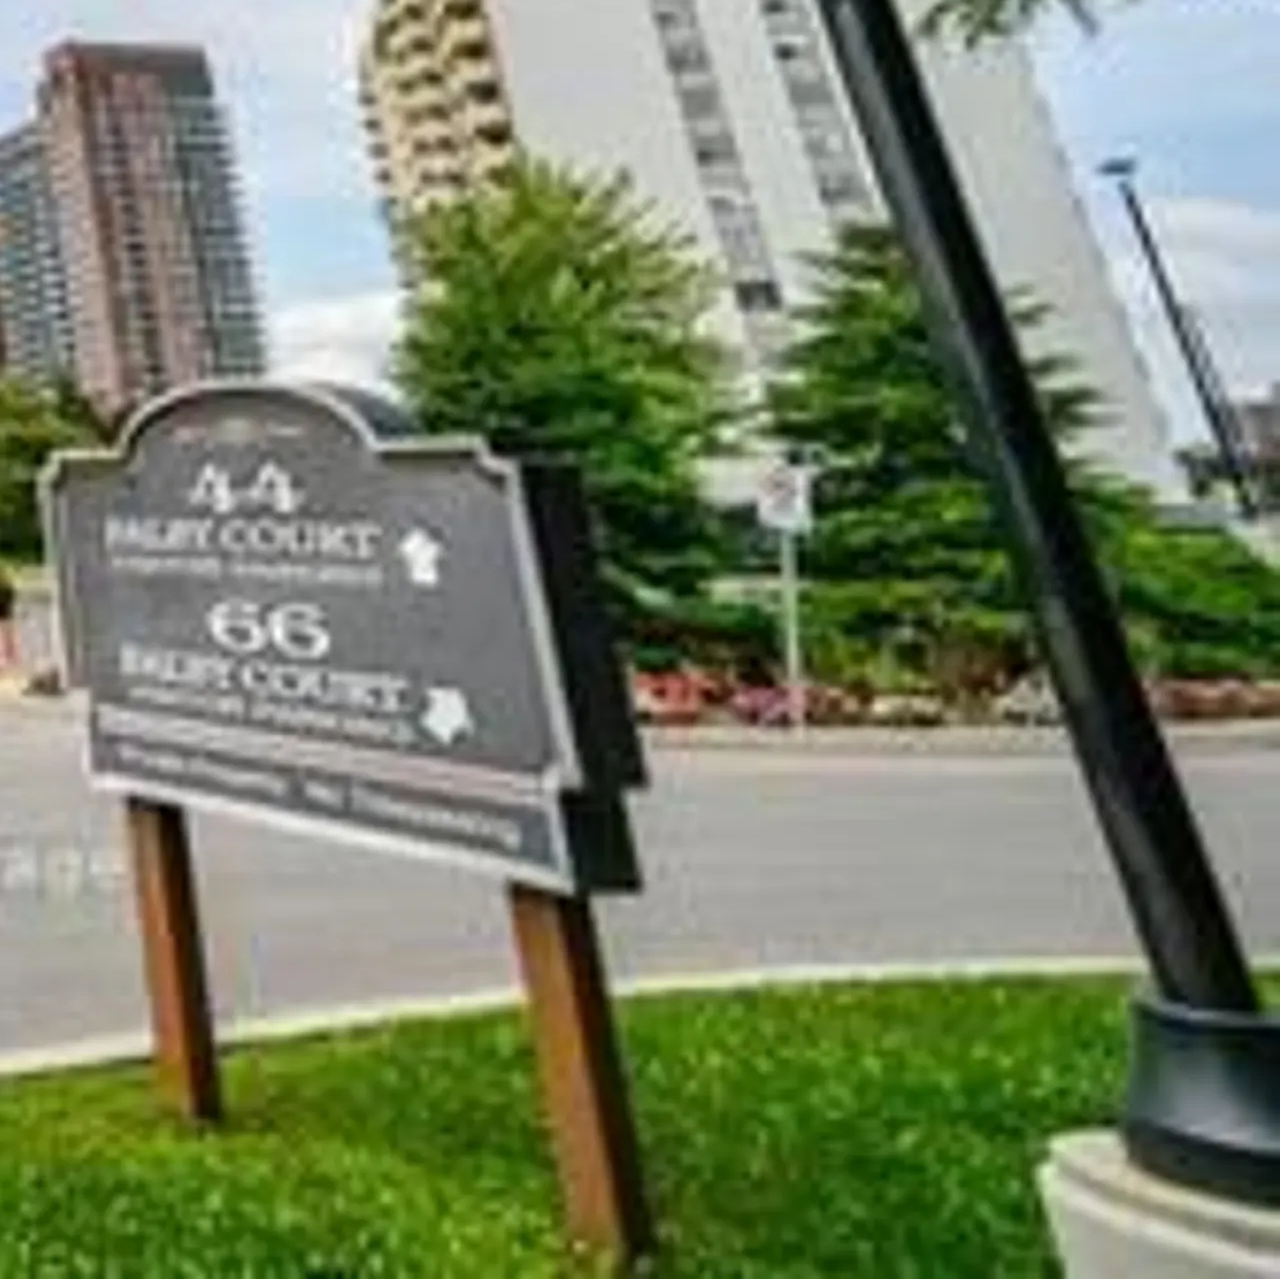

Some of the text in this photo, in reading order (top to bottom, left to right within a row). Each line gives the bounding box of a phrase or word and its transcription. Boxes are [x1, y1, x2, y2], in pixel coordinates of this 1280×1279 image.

[189, 460, 306, 513] 44
[217, 519, 384, 559] COURT
[206, 602, 331, 661] 66
